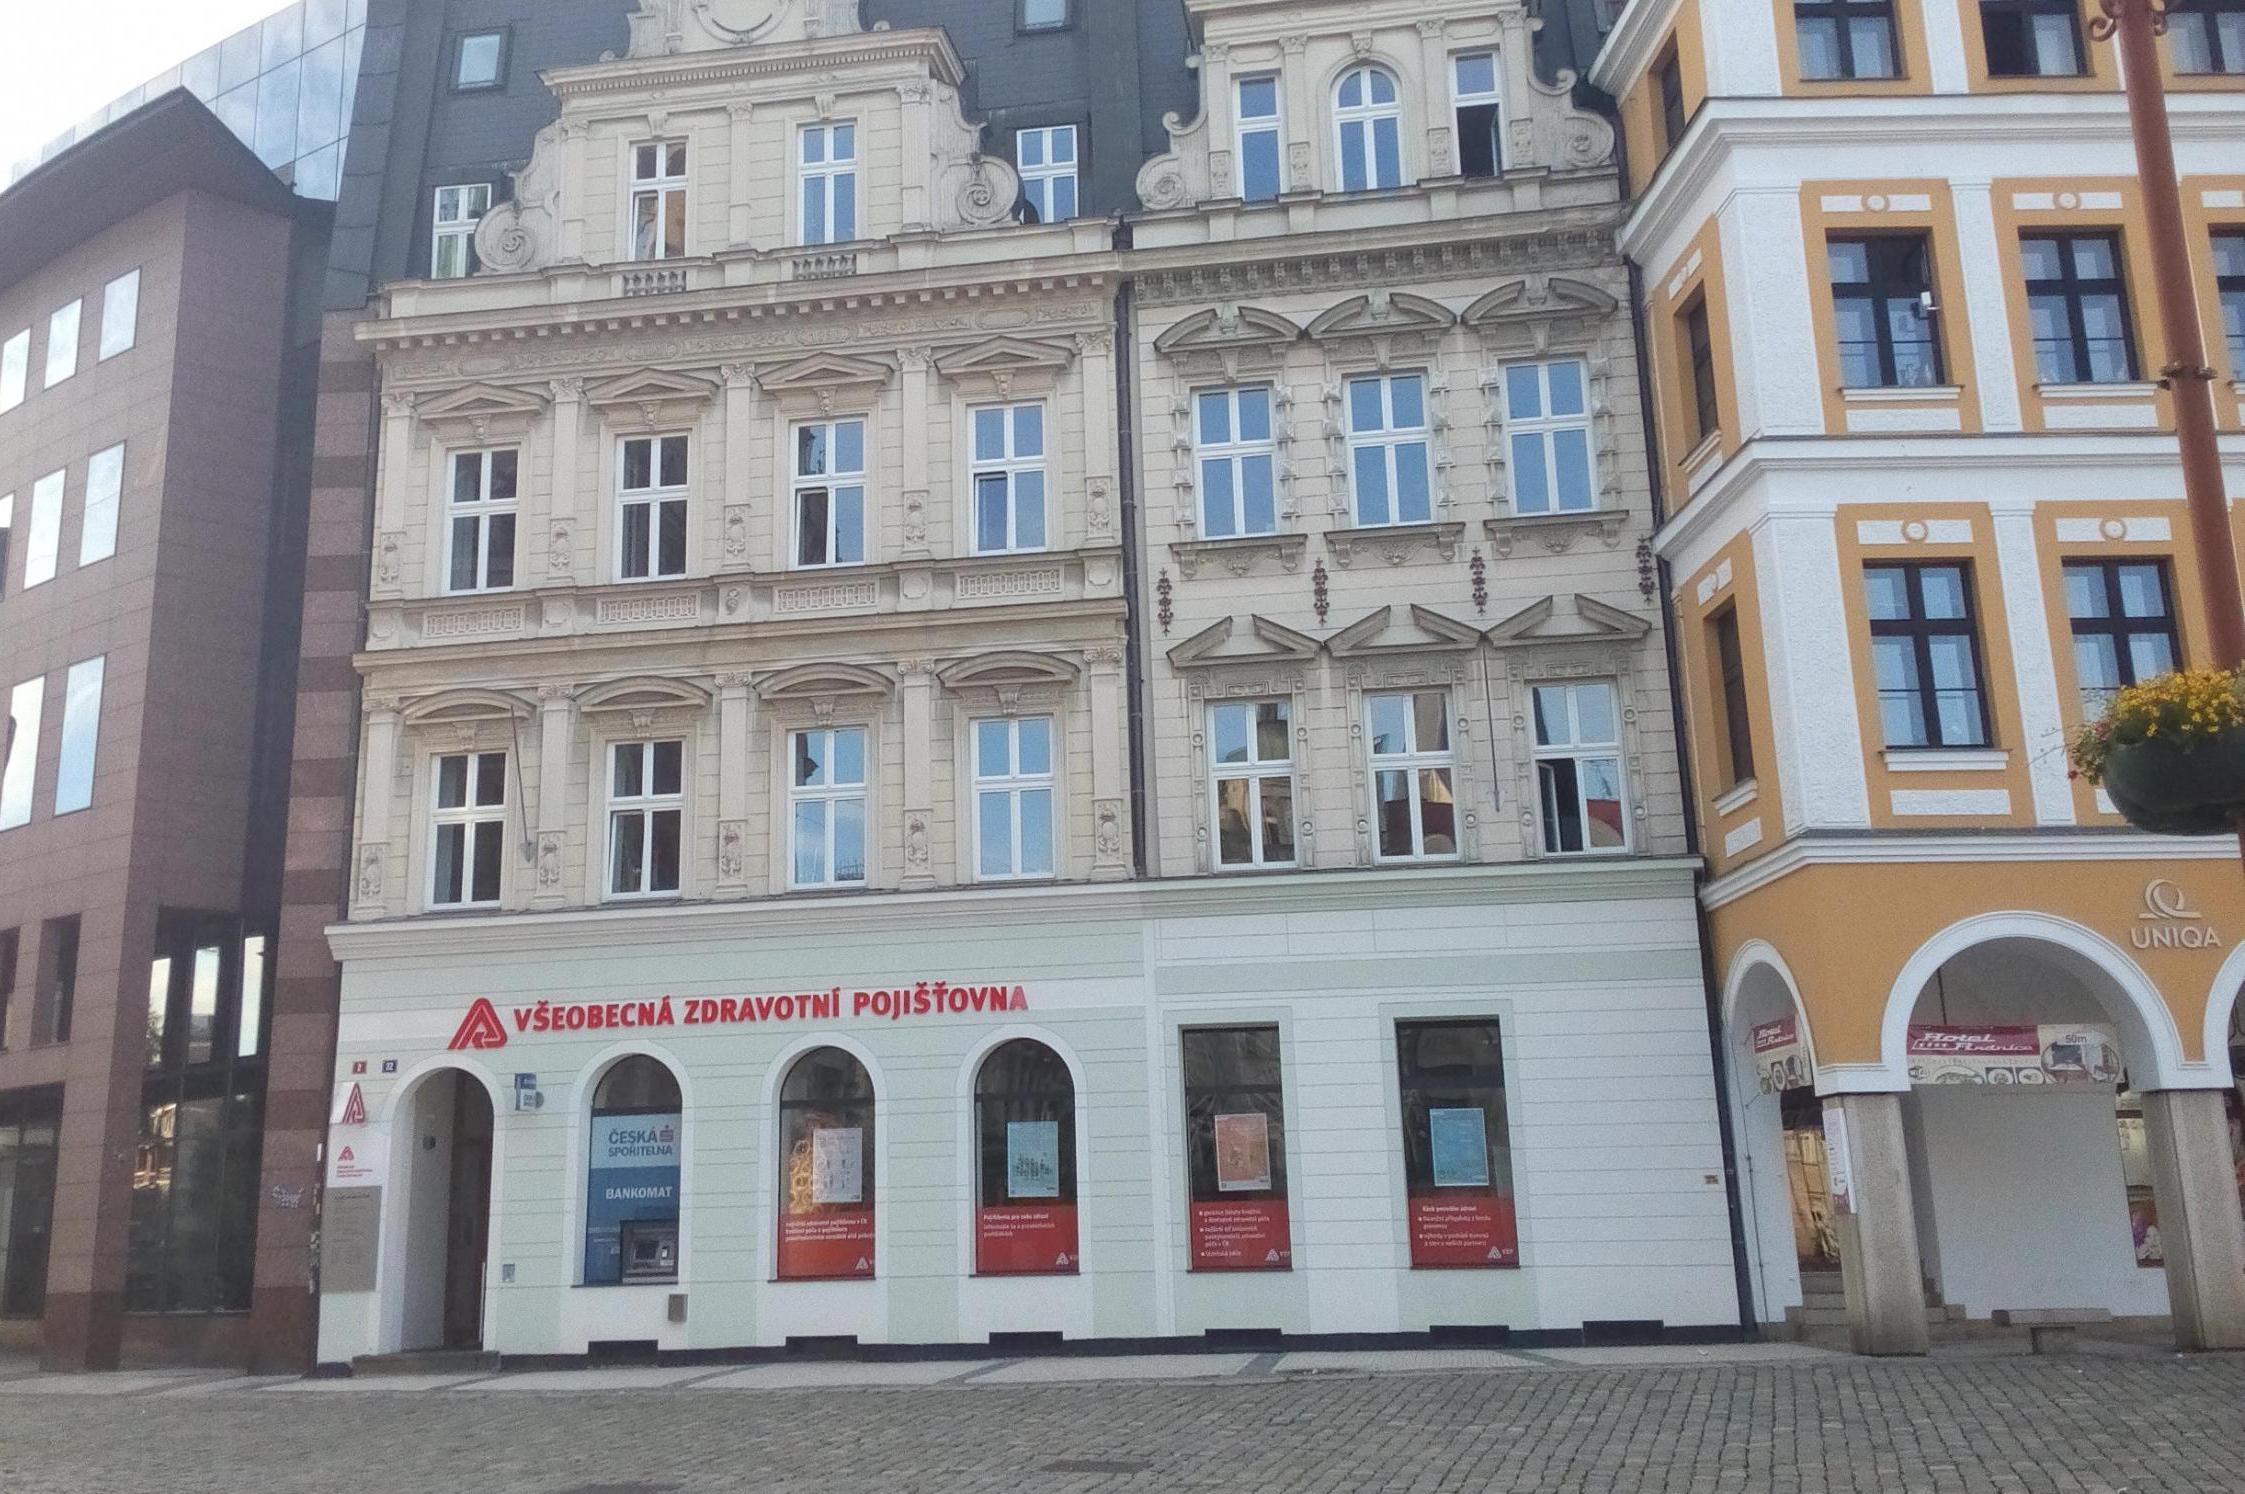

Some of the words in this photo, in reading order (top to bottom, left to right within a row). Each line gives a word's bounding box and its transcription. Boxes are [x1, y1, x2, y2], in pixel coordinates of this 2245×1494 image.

[2130, 926, 2222, 949] UNIQA
[513, 995, 675, 1032] VŠEOBECNÁ
[684, 987, 841, 1025] ZDRAVOTNÍ
[853, 981, 1029, 1021] POJIŠŤOVNA
[1923, 1032, 1996, 1042] Hotel
[608, 1126, 658, 1144] ČESKÁ
[608, 1145, 673, 1158] SPOŘITELNA
[605, 1186, 673, 1199] BANKOMAT
